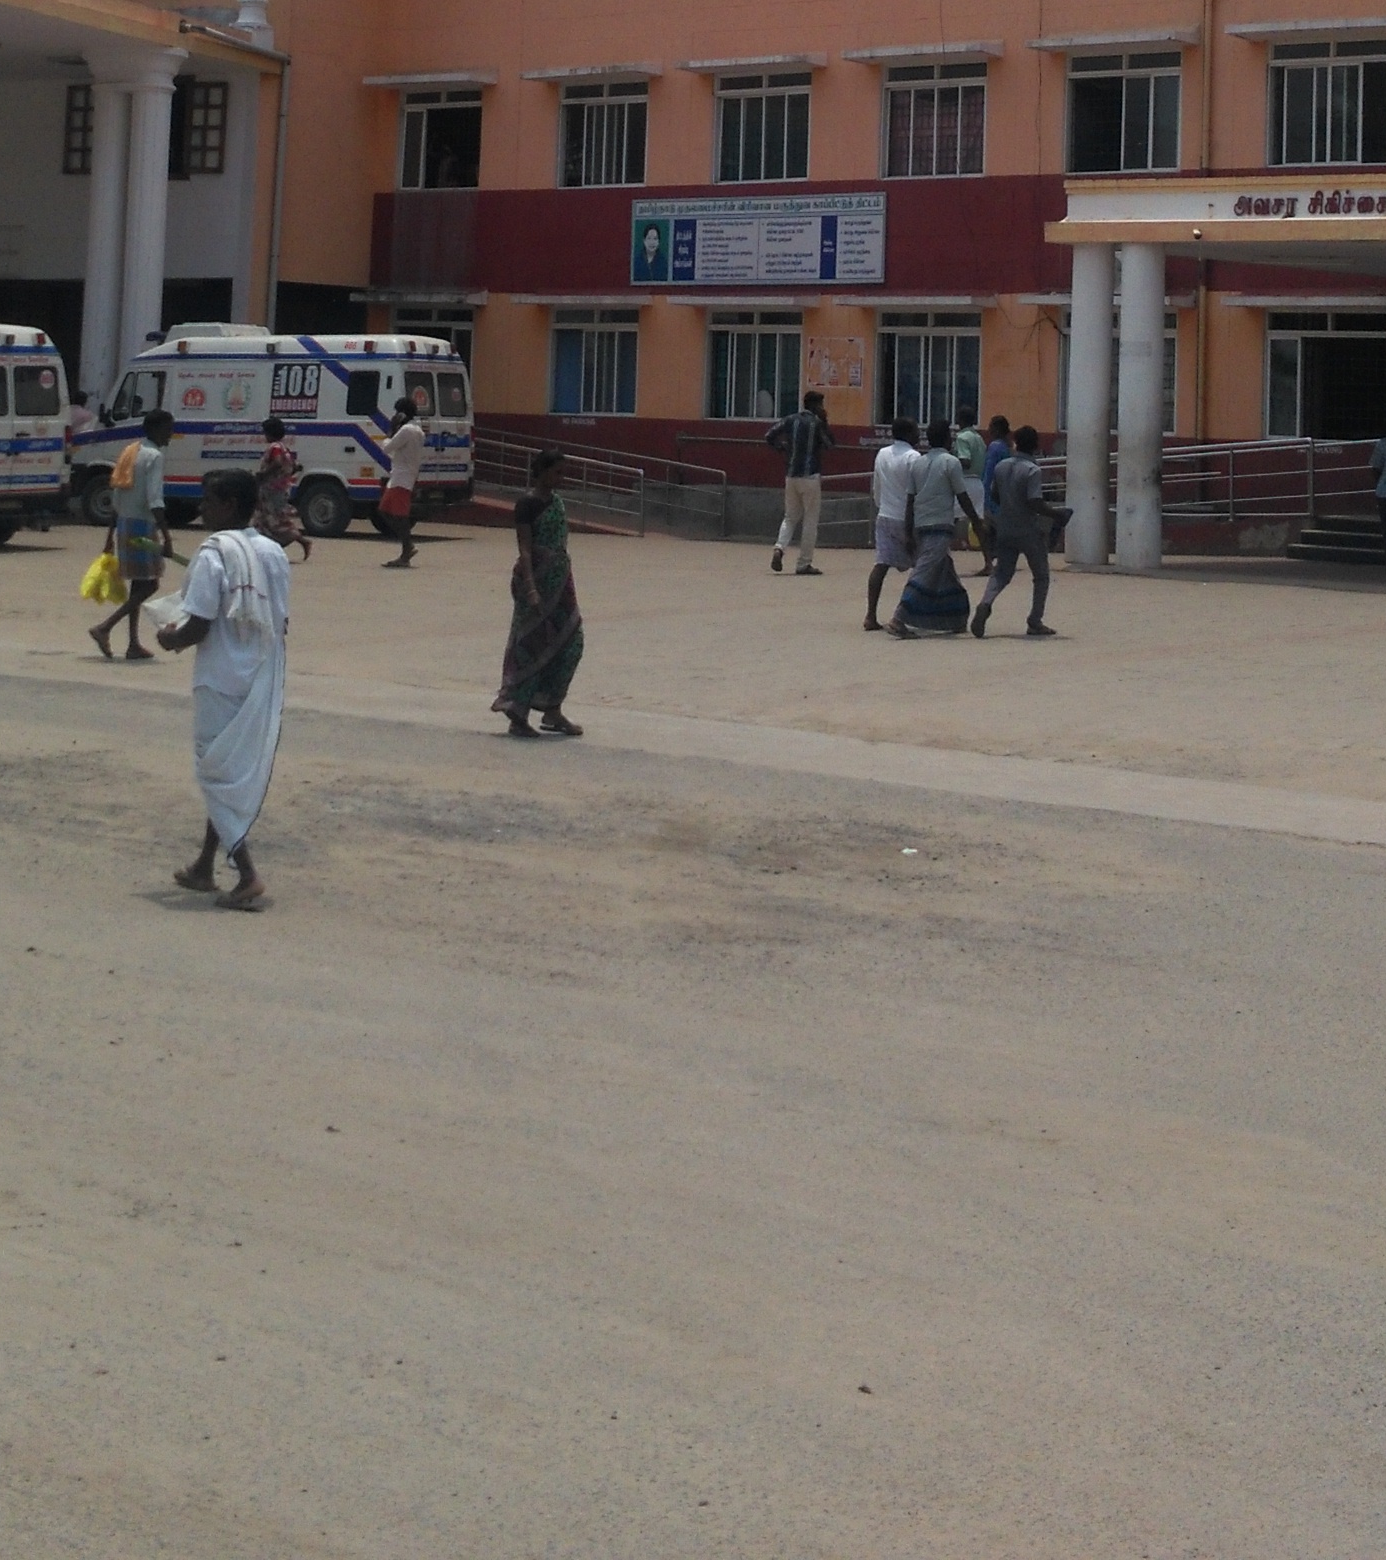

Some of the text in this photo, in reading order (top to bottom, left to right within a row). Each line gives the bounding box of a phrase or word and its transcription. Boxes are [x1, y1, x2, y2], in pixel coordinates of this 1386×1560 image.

[1234, 195, 1298, 218] அவசர
[277, 365, 319, 397] 108
[271, 398, 318, 411] EMERGENCY
